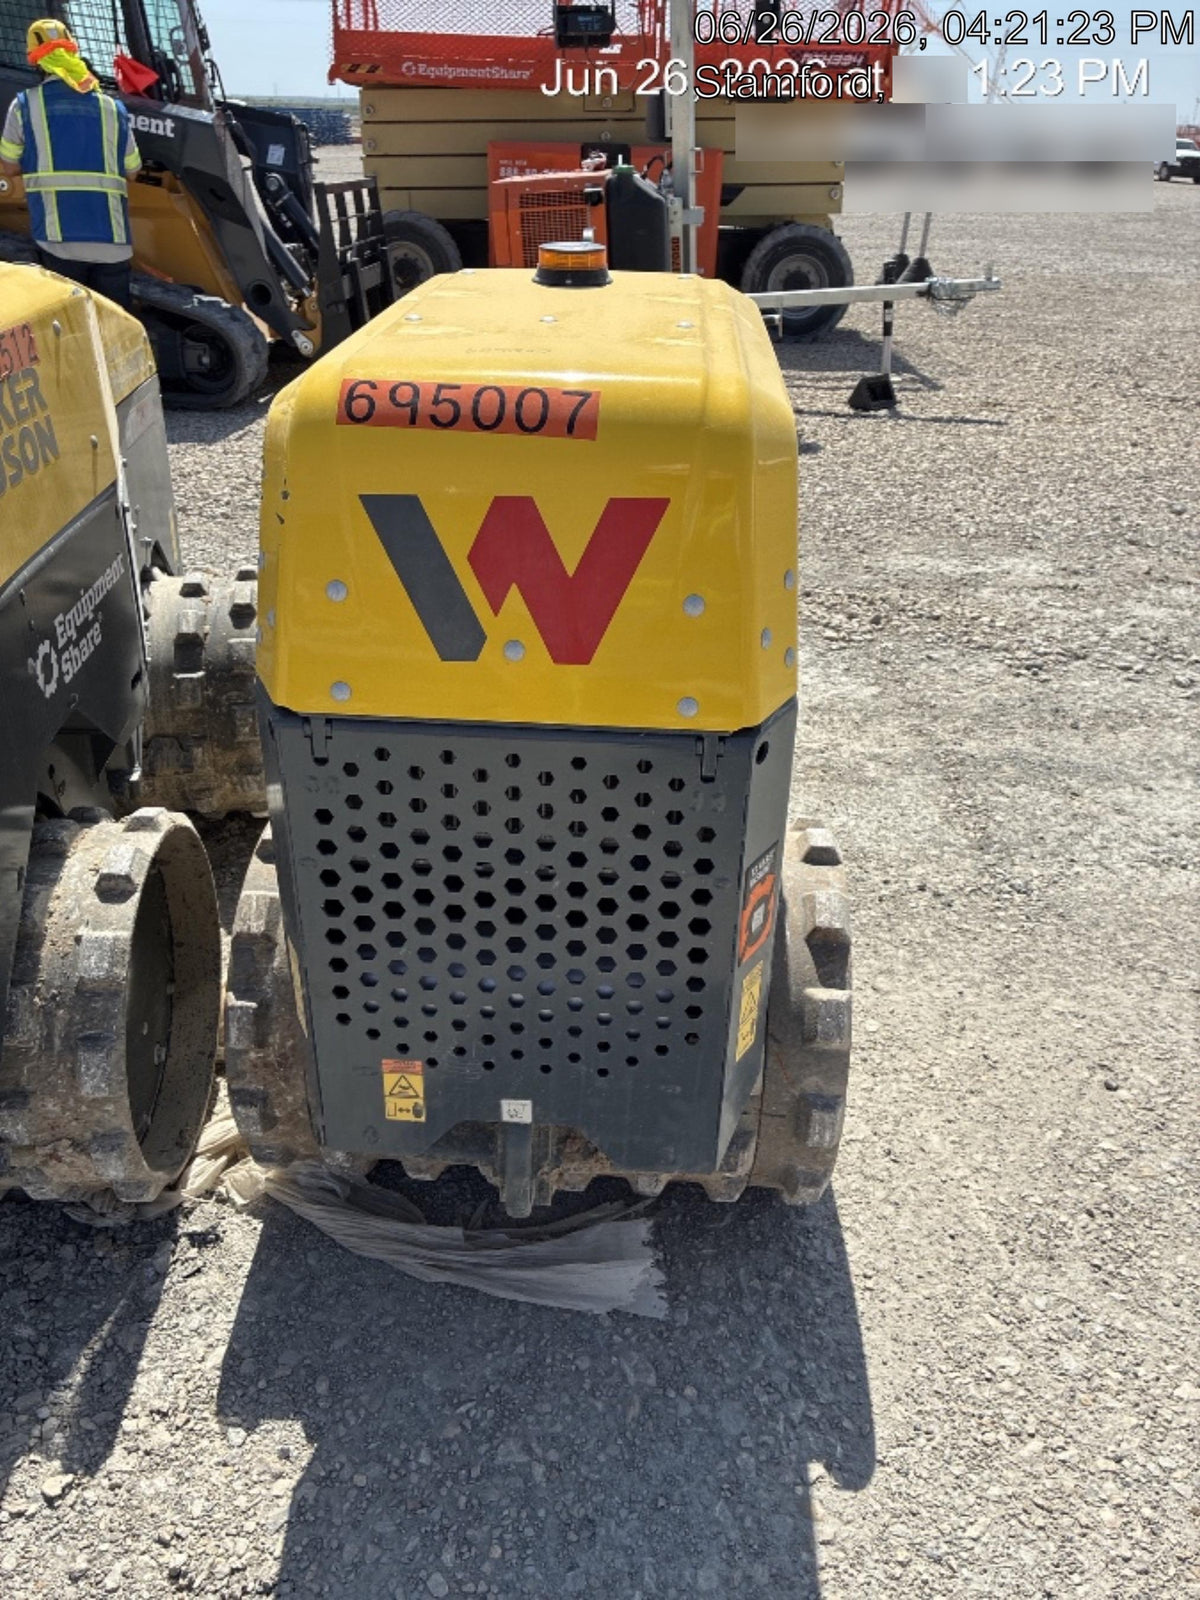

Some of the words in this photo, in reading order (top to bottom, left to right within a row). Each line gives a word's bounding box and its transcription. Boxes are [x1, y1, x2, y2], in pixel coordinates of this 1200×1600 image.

[416, 63, 531, 80] EquipmentShare
[343, 379, 593, 435] 695007
[54, 553, 126, 649] Equipment
[61, 621, 103, 684] Share
